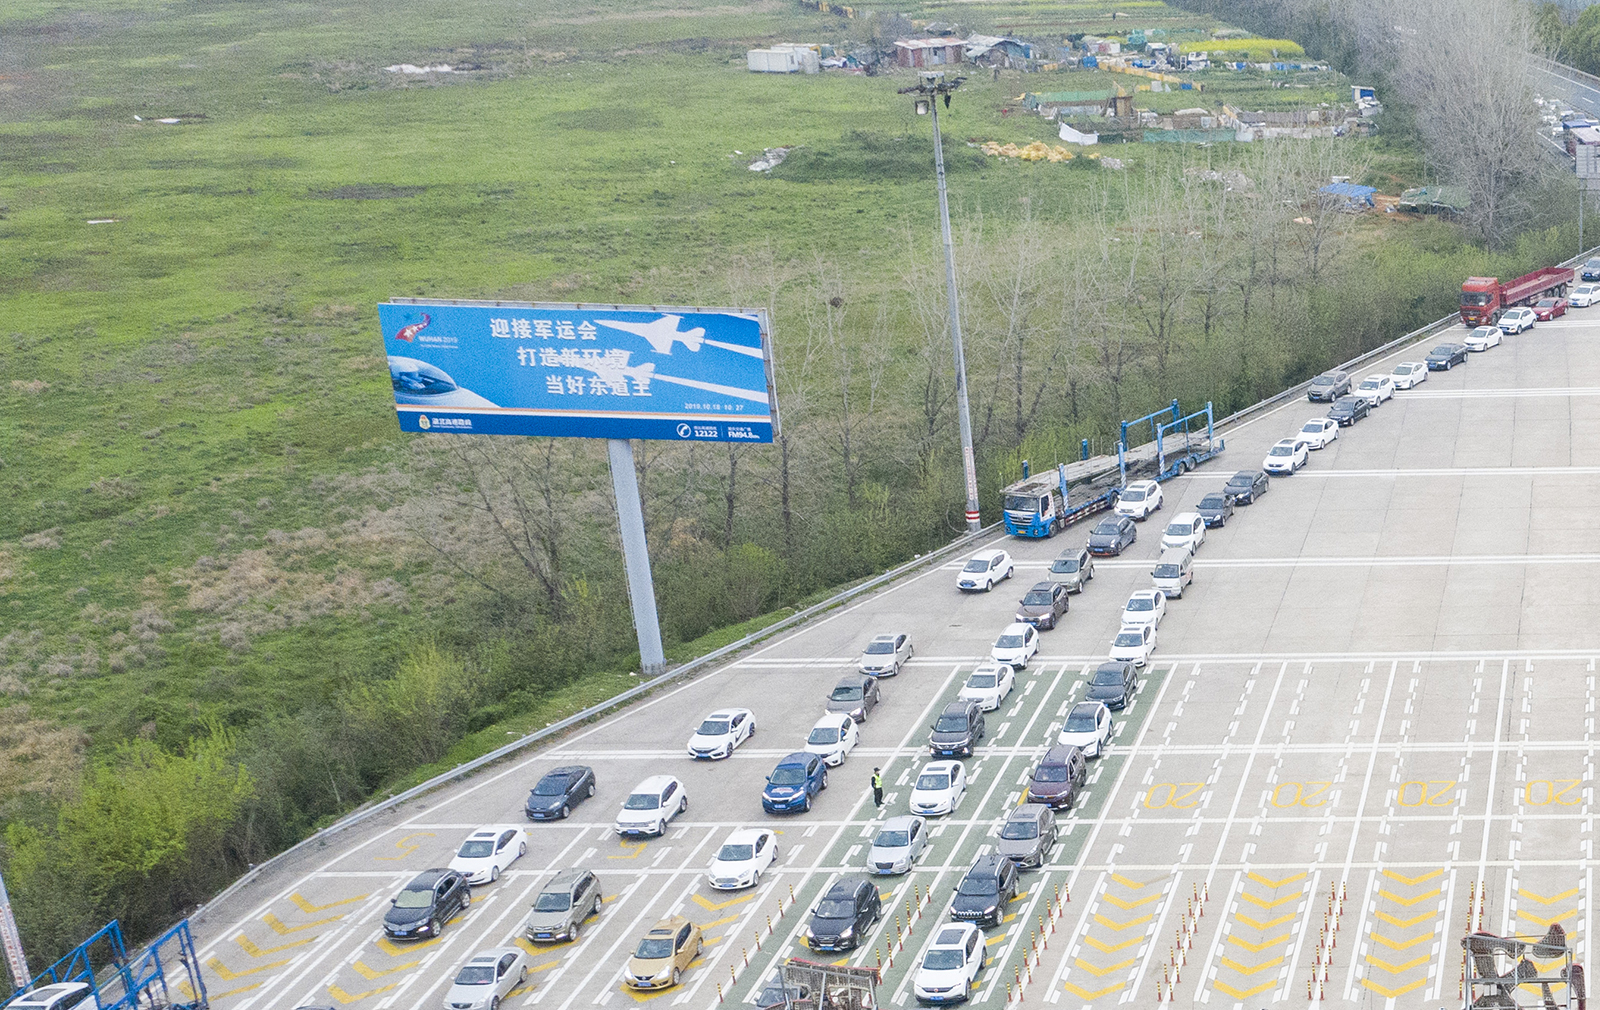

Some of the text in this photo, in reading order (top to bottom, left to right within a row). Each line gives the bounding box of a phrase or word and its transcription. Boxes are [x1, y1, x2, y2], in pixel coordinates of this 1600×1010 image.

[490, 318, 597, 340] 迎接军运会
[517, 346, 627, 369] 打造新环境
[546, 375, 652, 396] 当好东道主
[694, 430, 718, 438] 12122
[1143, 782, 1205, 809] 20
[1270, 781, 1332, 808] 20
[1397, 780, 1456, 807] 20
[1524, 779, 1583, 806] 20
